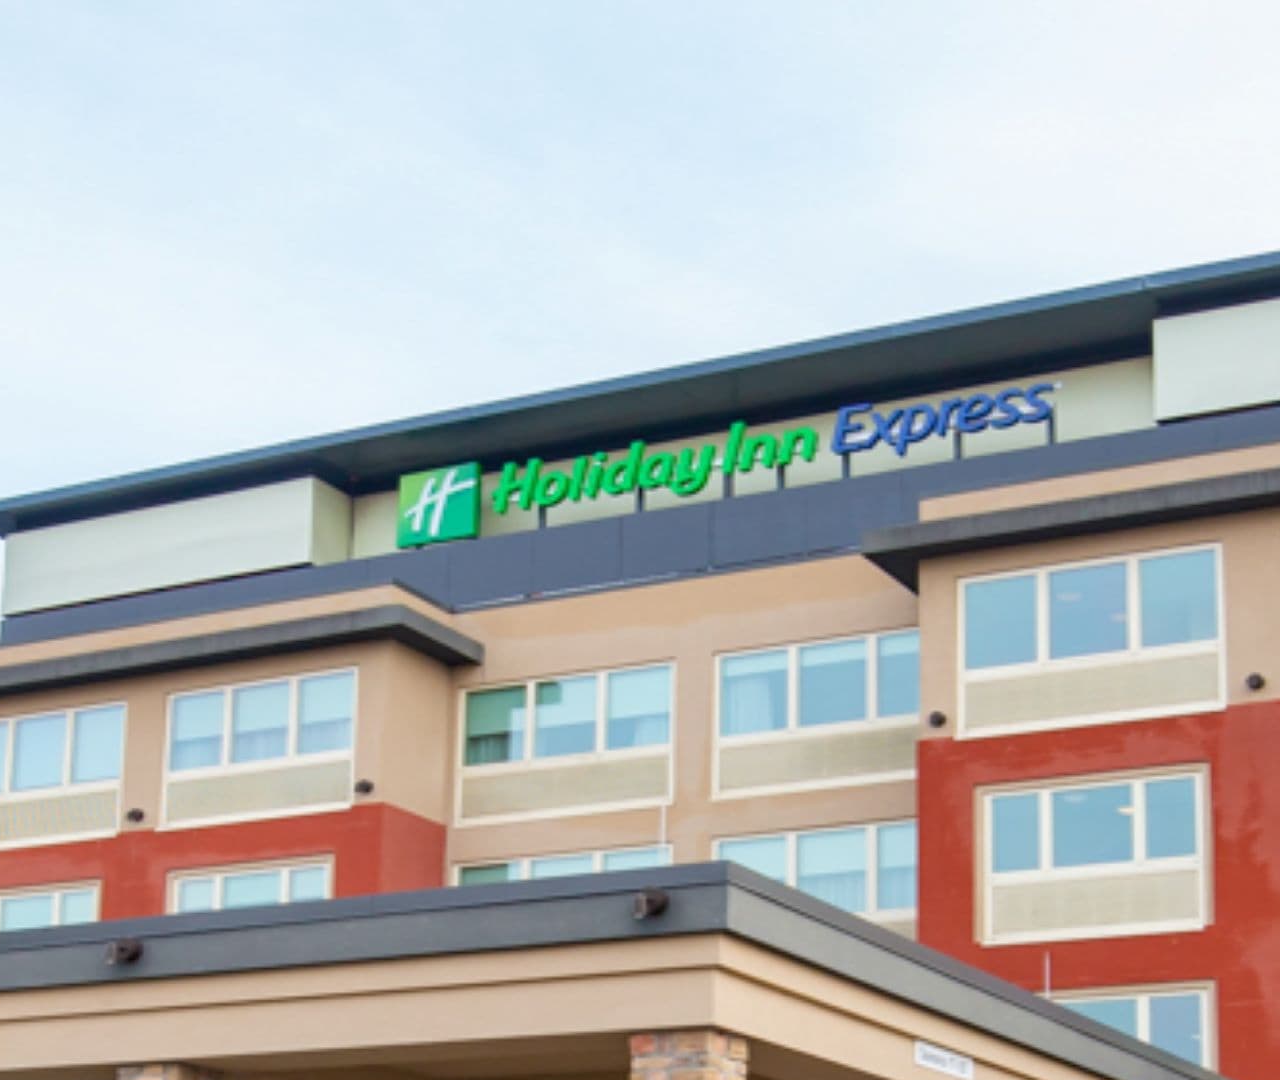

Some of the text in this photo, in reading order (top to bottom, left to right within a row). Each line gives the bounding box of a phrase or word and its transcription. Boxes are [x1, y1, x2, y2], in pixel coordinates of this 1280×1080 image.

[492, 383, 1055, 514] Holiday Inn Express
